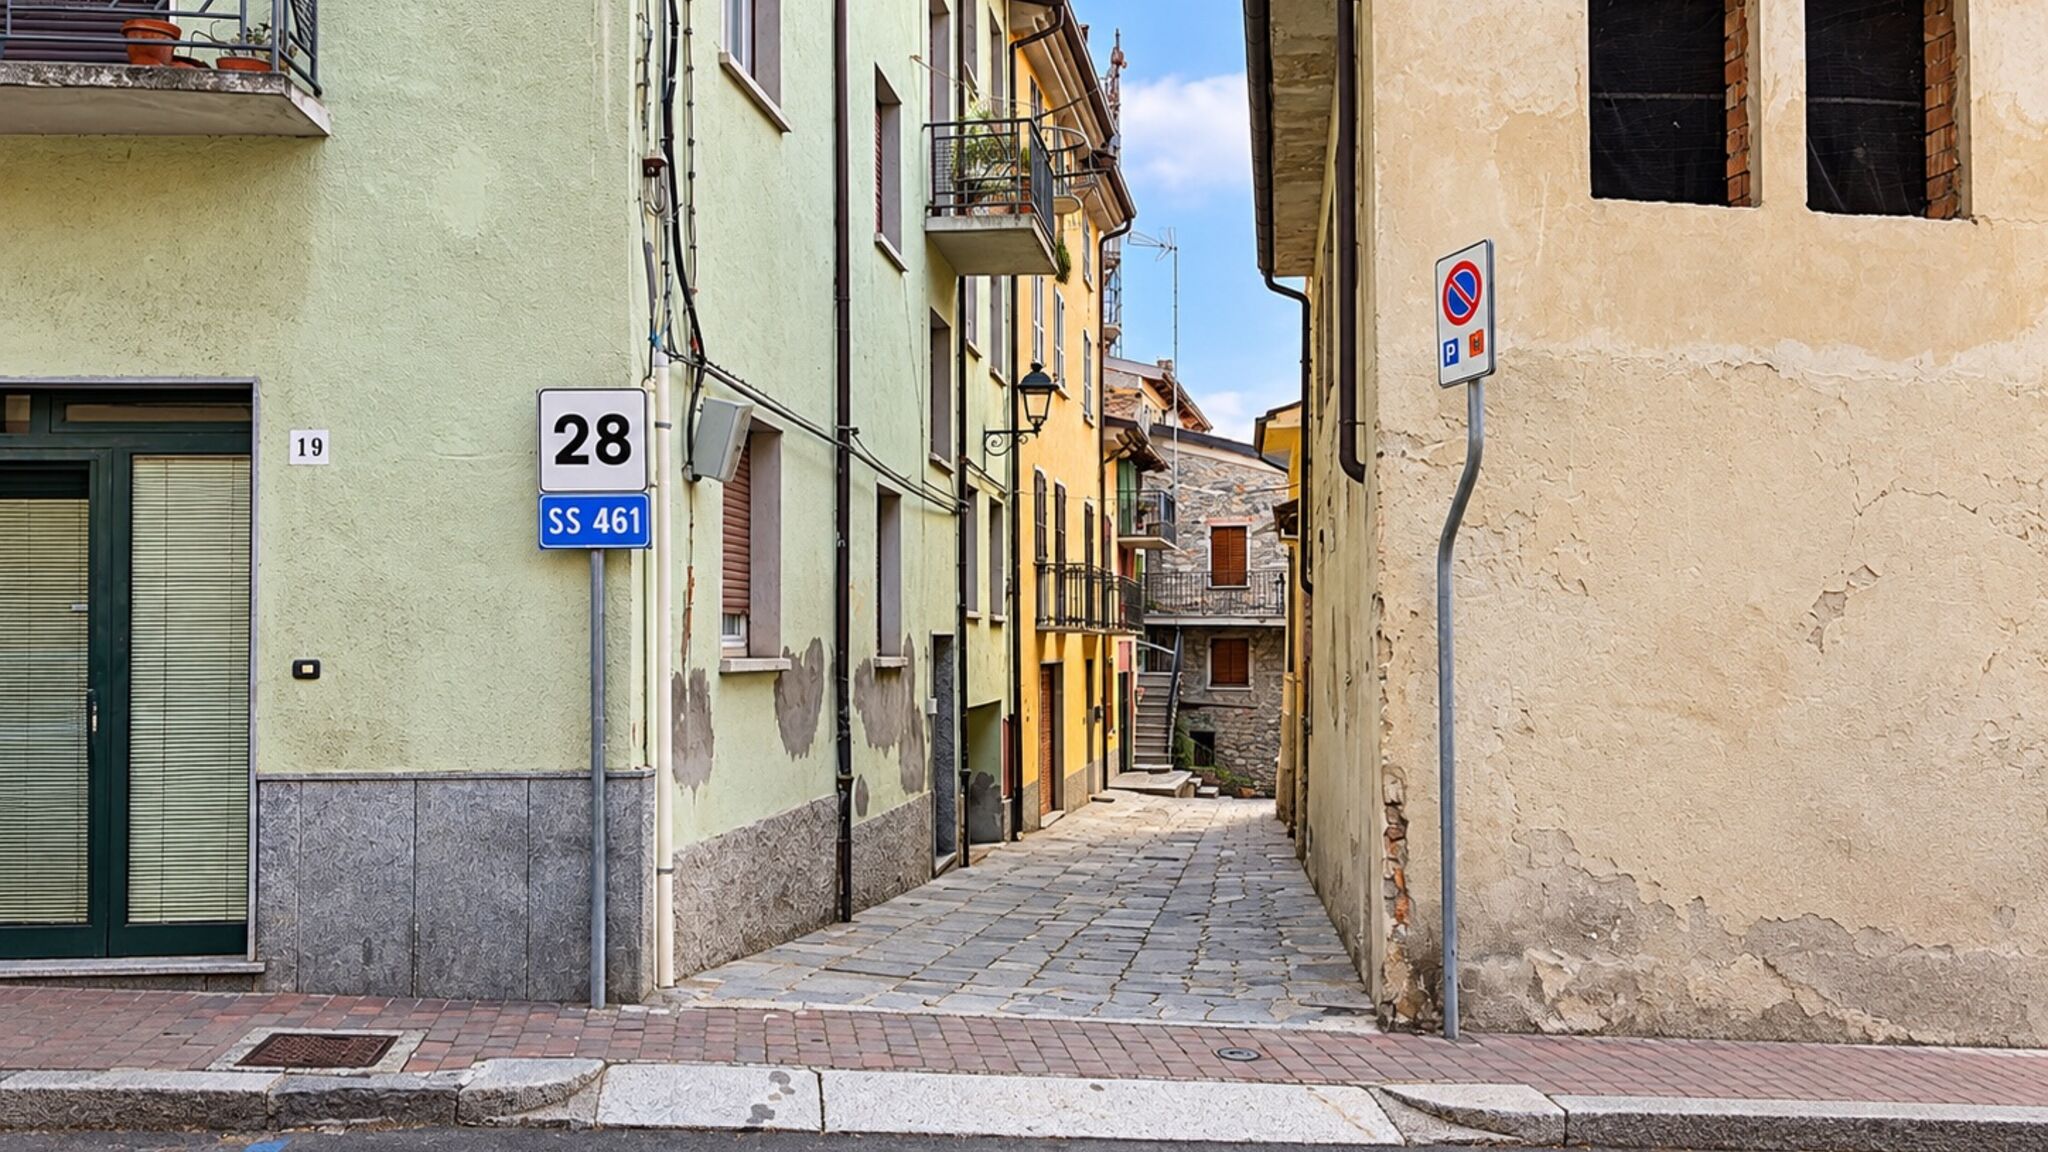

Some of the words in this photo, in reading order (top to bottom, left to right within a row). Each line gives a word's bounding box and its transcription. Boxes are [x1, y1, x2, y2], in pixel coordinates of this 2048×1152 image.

[1446, 343, 1456, 363] P
[298, 437, 323, 457] 19
[554, 413, 631, 465] 28
[549, 507, 581, 535] SS
[593, 507, 640, 535] 461
